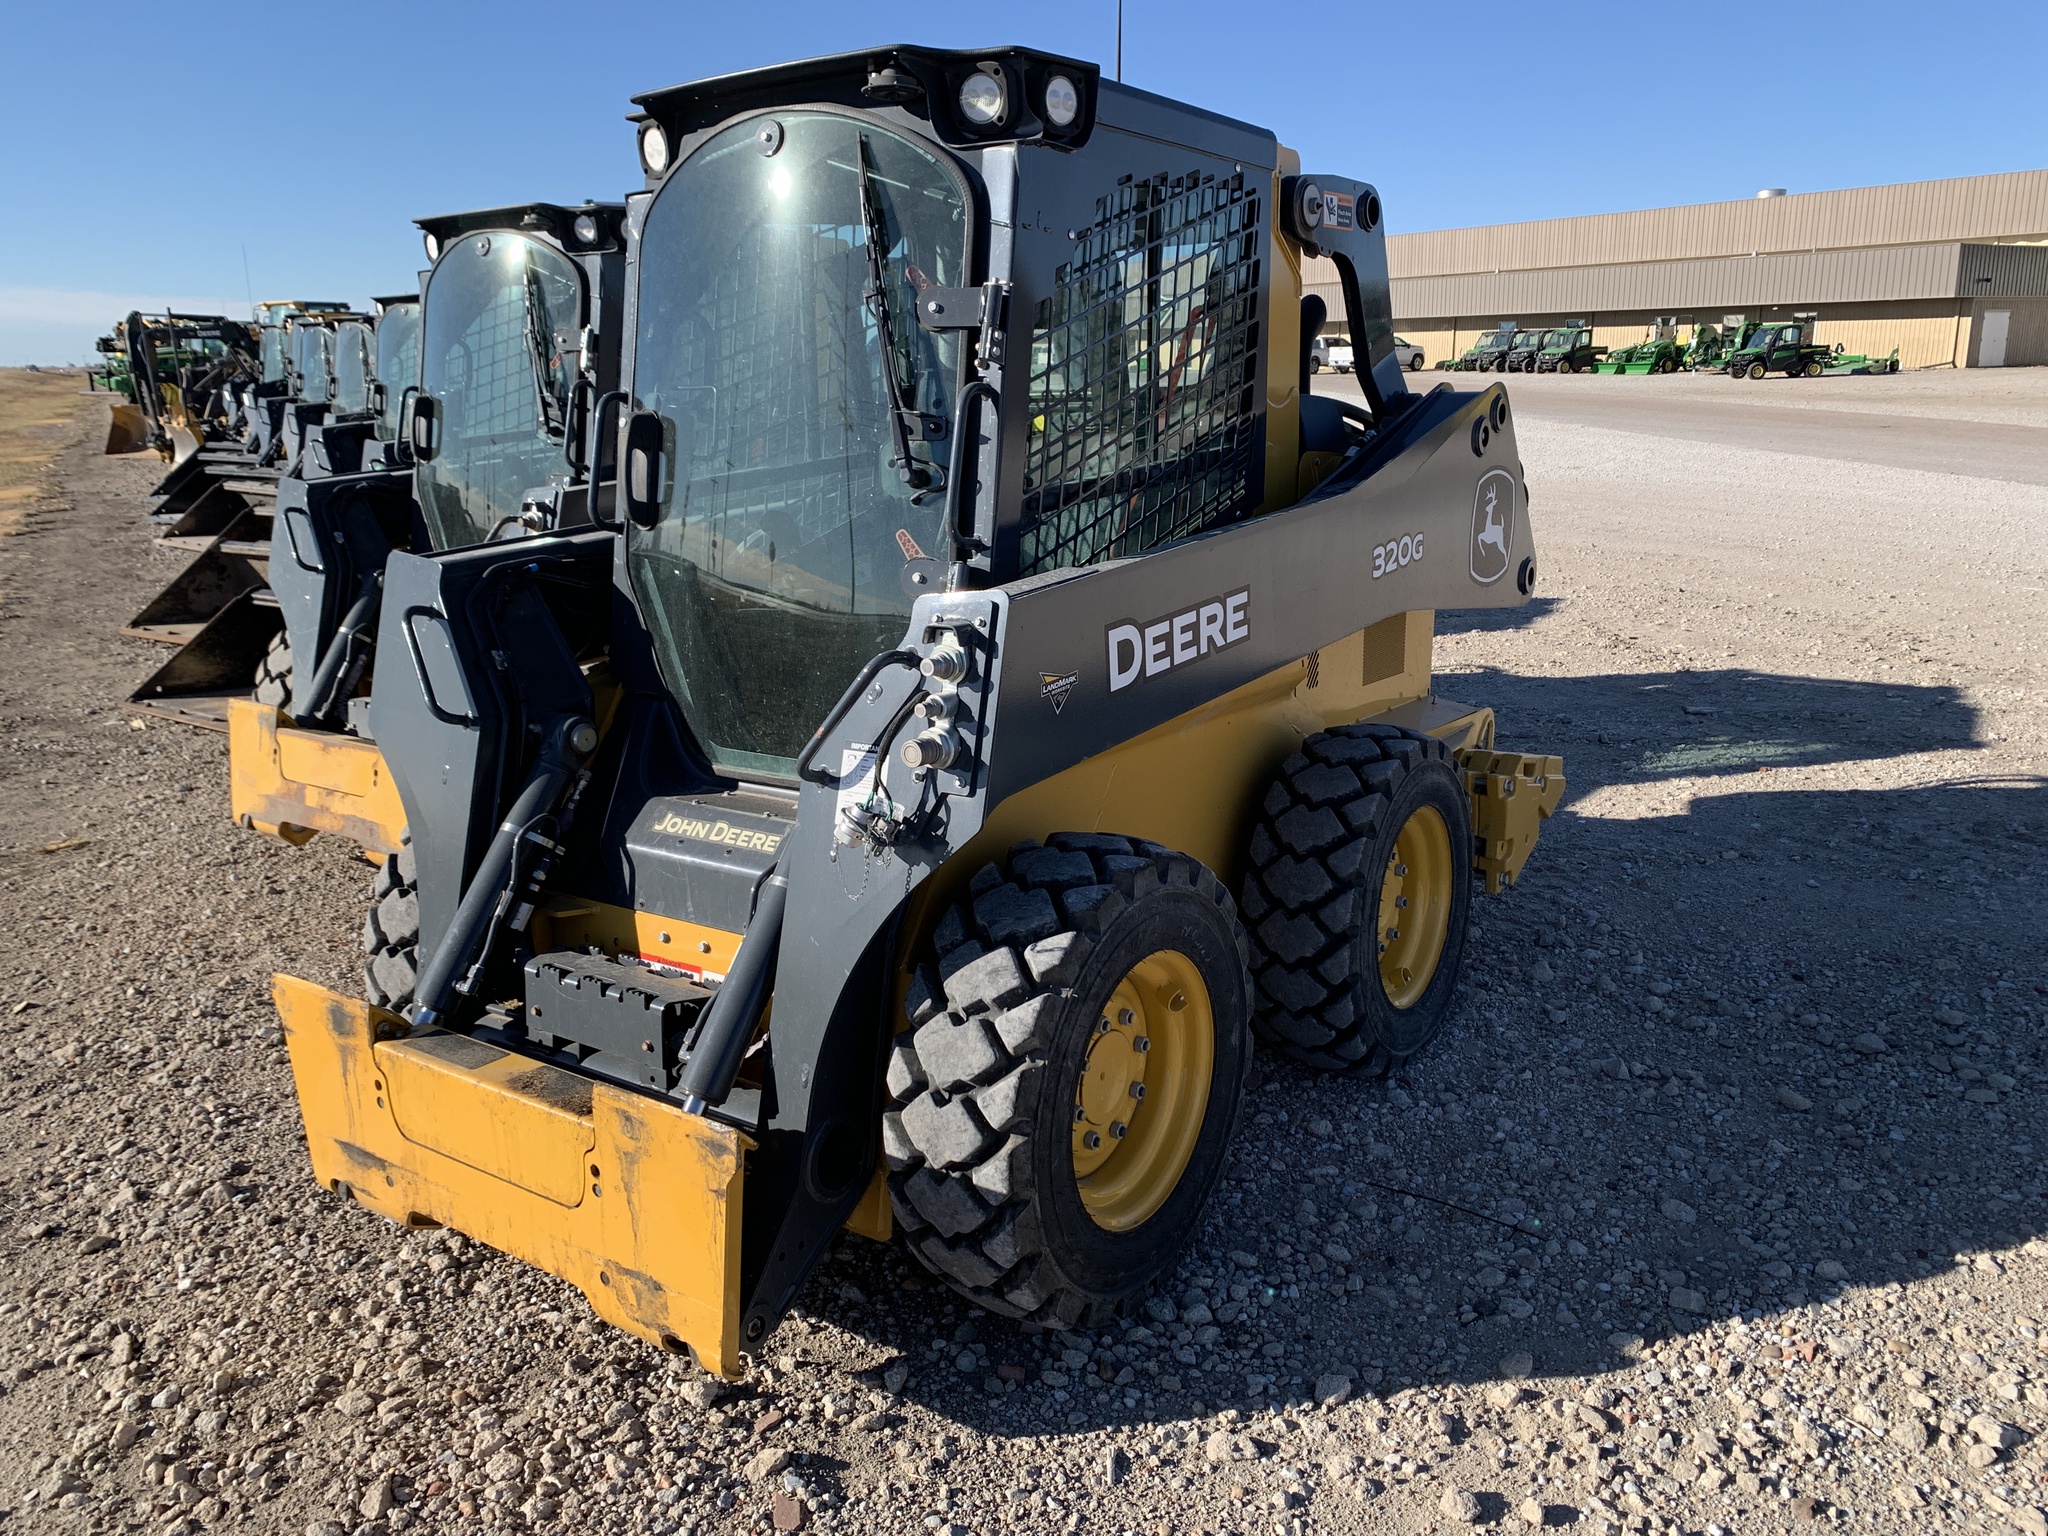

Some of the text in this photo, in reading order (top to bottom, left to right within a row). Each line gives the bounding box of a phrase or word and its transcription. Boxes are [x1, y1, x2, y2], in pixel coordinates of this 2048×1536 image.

[1372, 533, 1424, 578] 320G
[1108, 590, 1248, 692] DEERE
[1043, 675, 1077, 693] LANDMARK
[654, 813, 781, 852] JOHN DEERE
